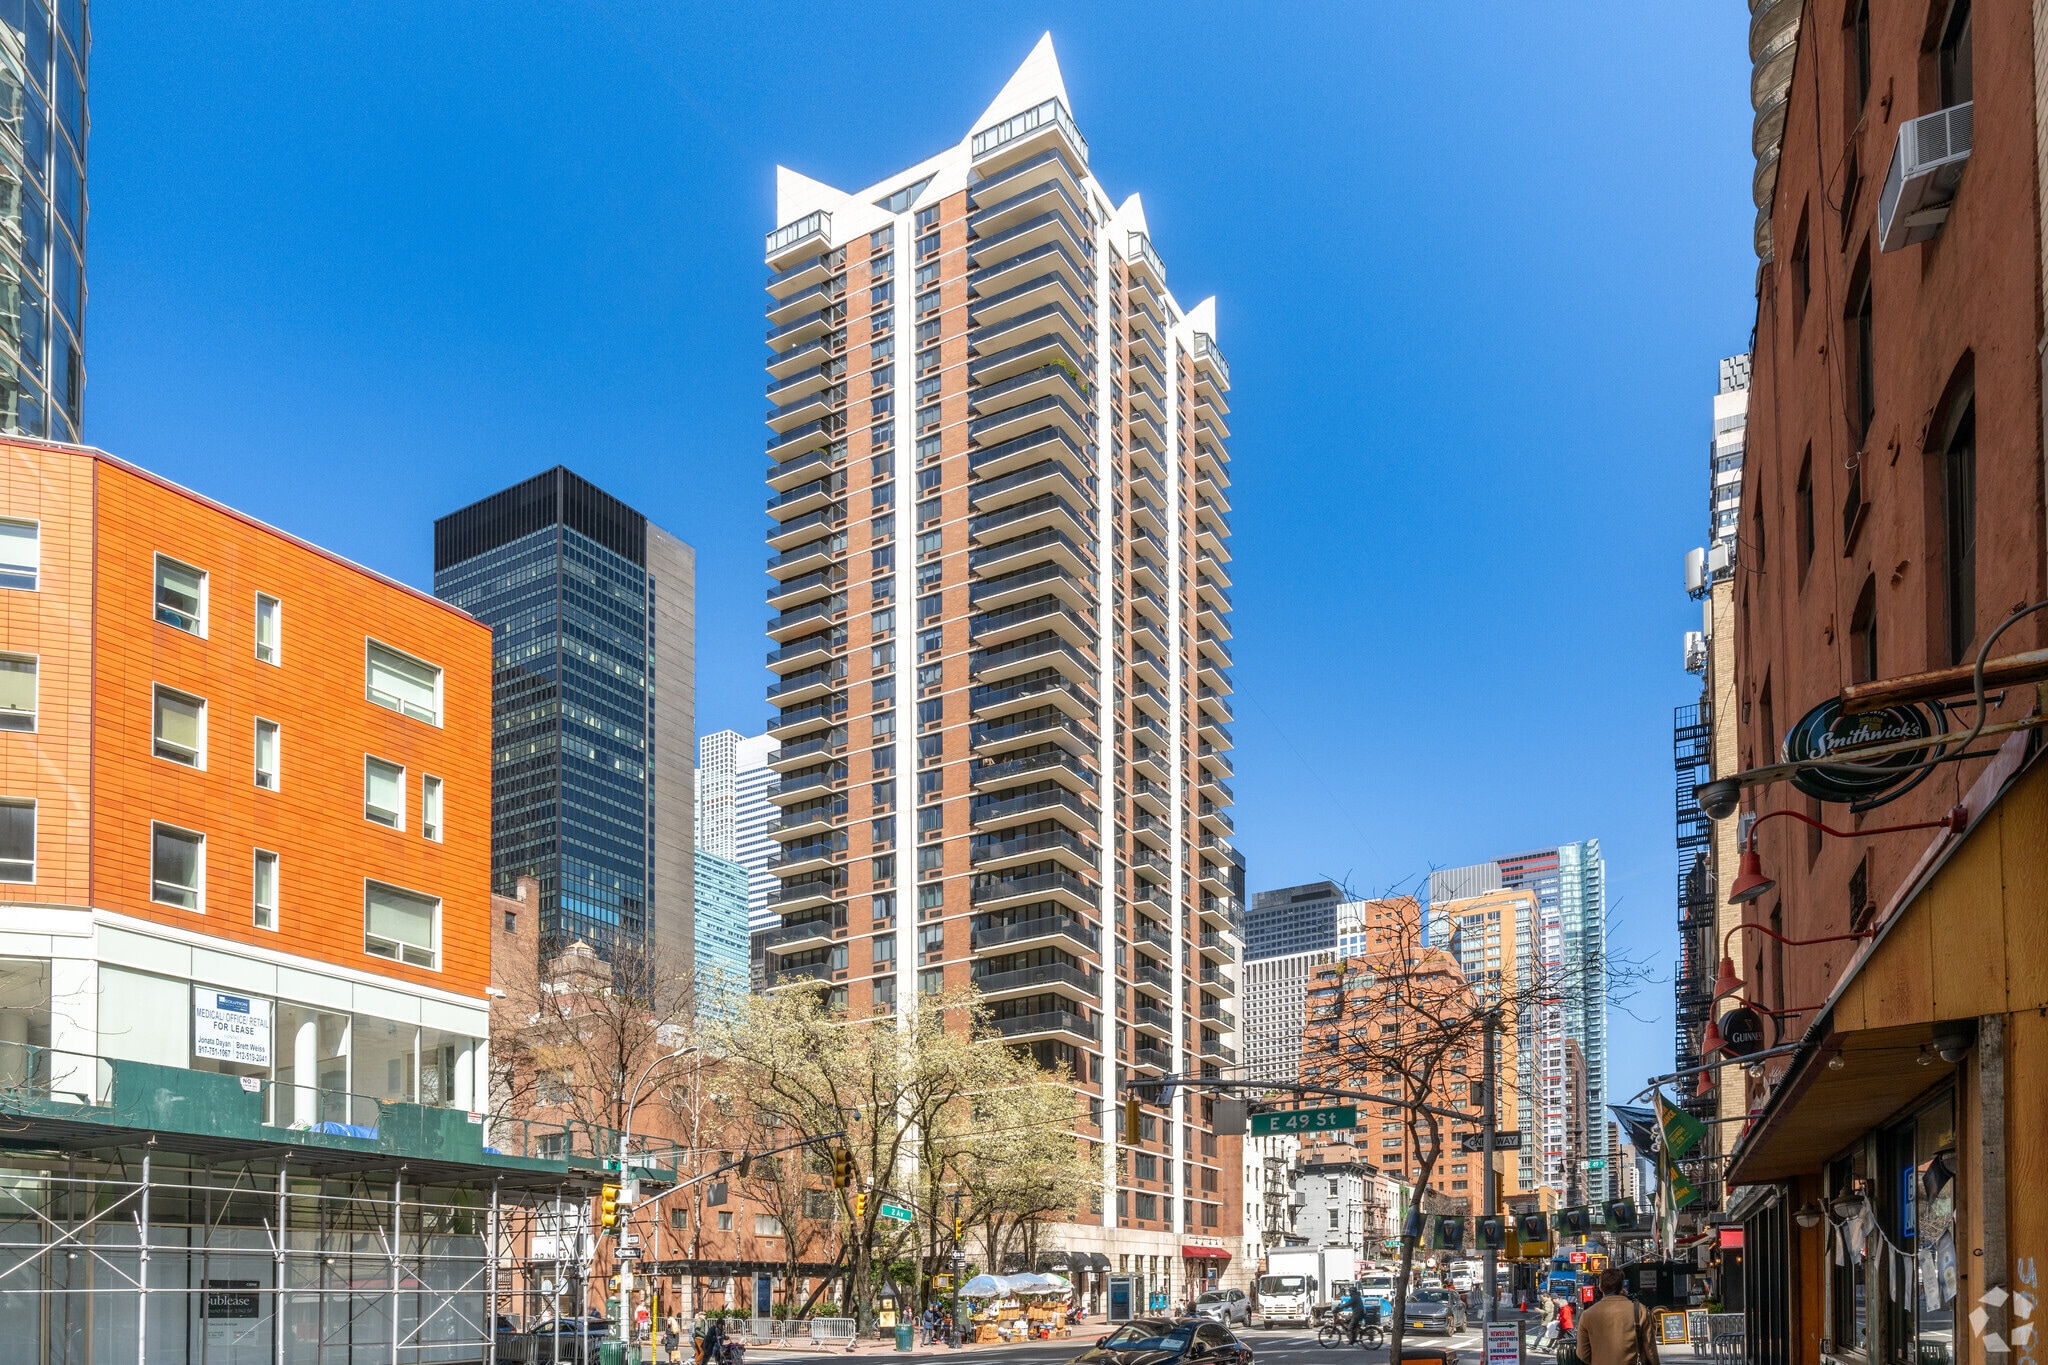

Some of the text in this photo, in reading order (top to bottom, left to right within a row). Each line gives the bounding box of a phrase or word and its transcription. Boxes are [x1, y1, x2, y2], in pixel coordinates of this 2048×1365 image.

[1809, 722, 1920, 760] Smithwick's
[213, 1021, 254, 1035] FOR LEASE
[250, 1017, 269, 1028] RETAIL
[1270, 1112, 1337, 1131] E 49 St
[1496, 1136, 1516, 1145] WAY
[891, 1208, 895, 1216] 2
[207, 1295, 250, 1306] ublease
